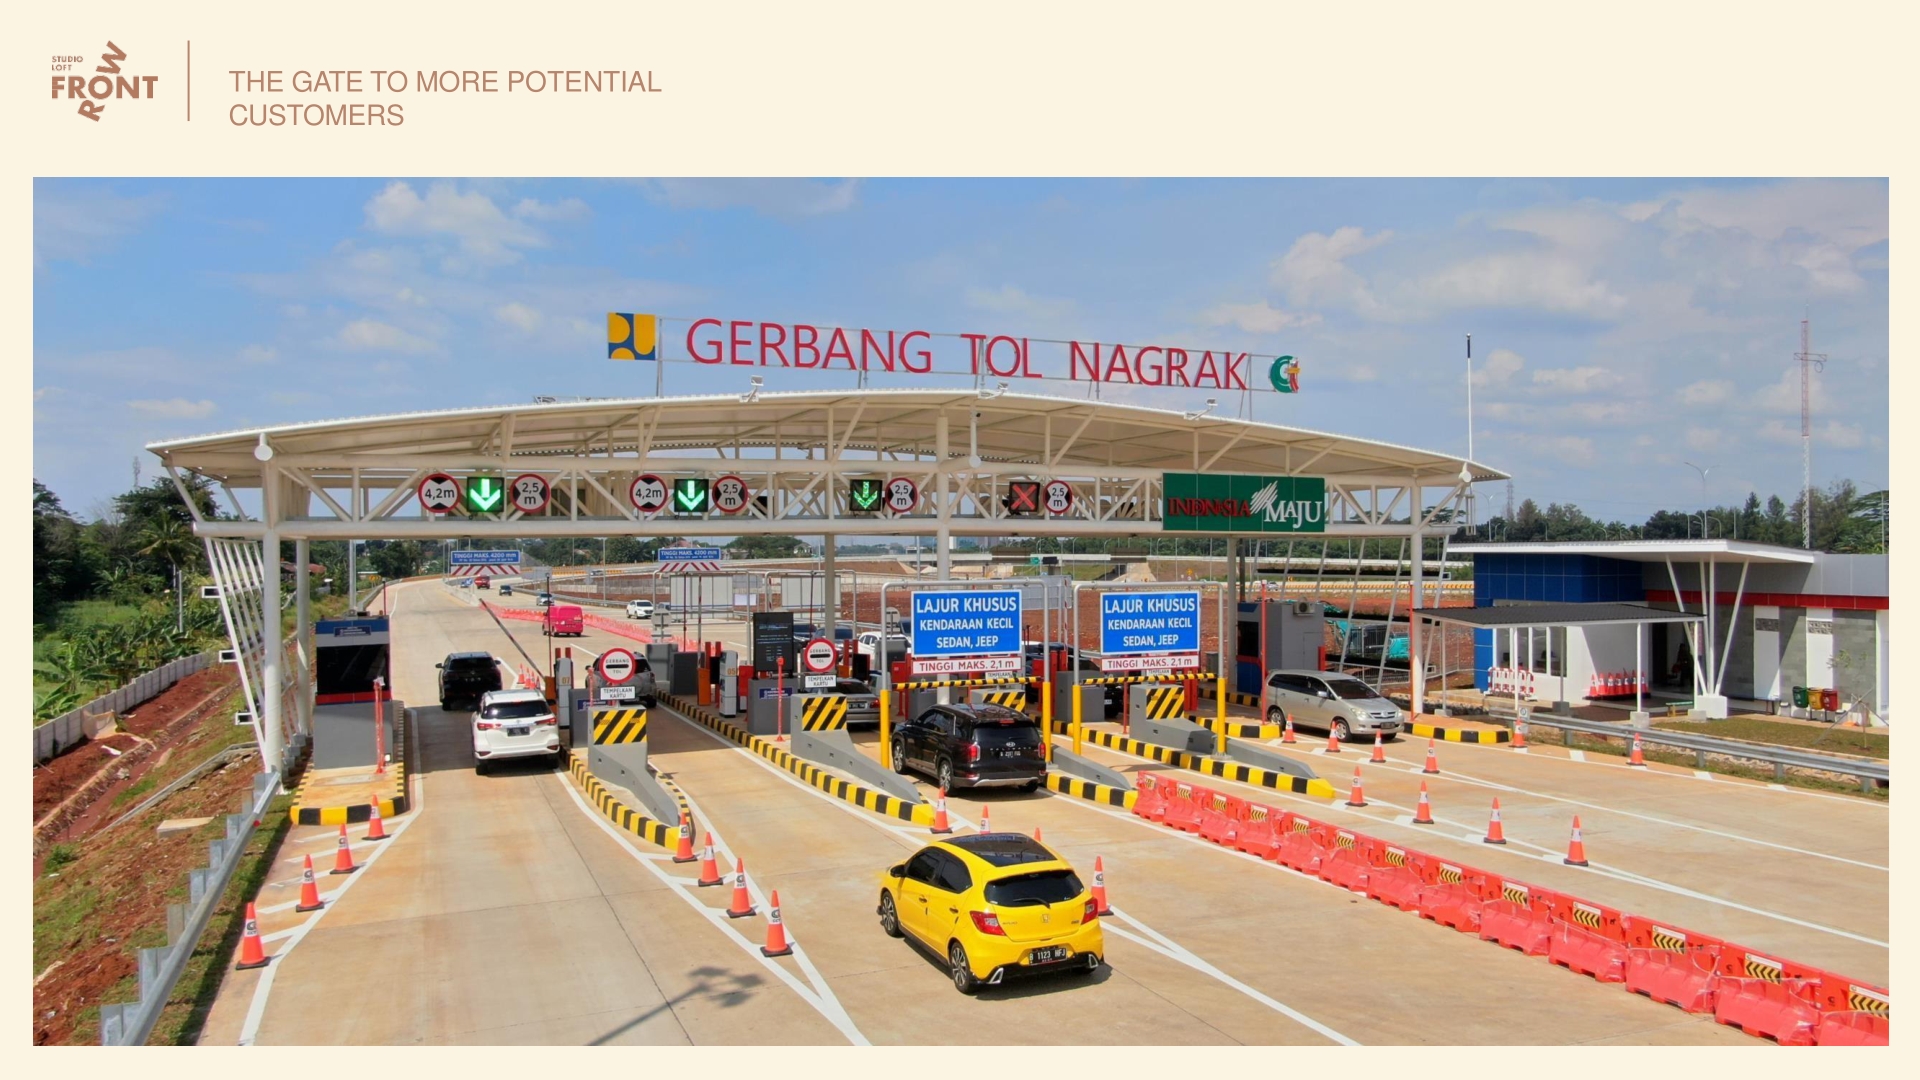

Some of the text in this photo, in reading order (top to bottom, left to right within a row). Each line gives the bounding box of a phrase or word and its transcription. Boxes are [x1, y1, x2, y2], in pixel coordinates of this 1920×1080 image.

[686, 318, 1248, 390] GERBANG TOL NAGRAK
[522, 482, 539, 494] 2,5
[635, 488, 662, 499] 4,2m
[723, 483, 738, 494] 2,5
[895, 485, 909, 495] 2,5
[1052, 488, 1065, 498] 2,5
[425, 488, 455, 500] 4,2m
[524, 496, 536, 505] m
[725, 496, 736, 506] m
[897, 497, 907, 506] m
[1053, 499, 1063, 507] m
[1264, 500, 1322, 529] MAJU
[916, 597, 1017, 613] LAJUR KHUSUS
[1105, 597, 1195, 613] LAJUR KHUSUS
[920, 617, 1013, 631] KENDARAAN KECIL
[1108, 617, 1192, 630] KENDARAAN KECIL
[936, 635, 999, 649] SEDAN, JEEP
[1123, 634, 1179, 647] SEDAN, JEEP
[919, 660, 1014, 671] TINGGI MAKS. 2,1 m
[1108, 660, 1138, 669] TINGGI
[1142, 658, 1169, 668] MAKS.
[1170, 658, 1182, 668] 2,1
[1037, 950, 1051, 960] 1123
